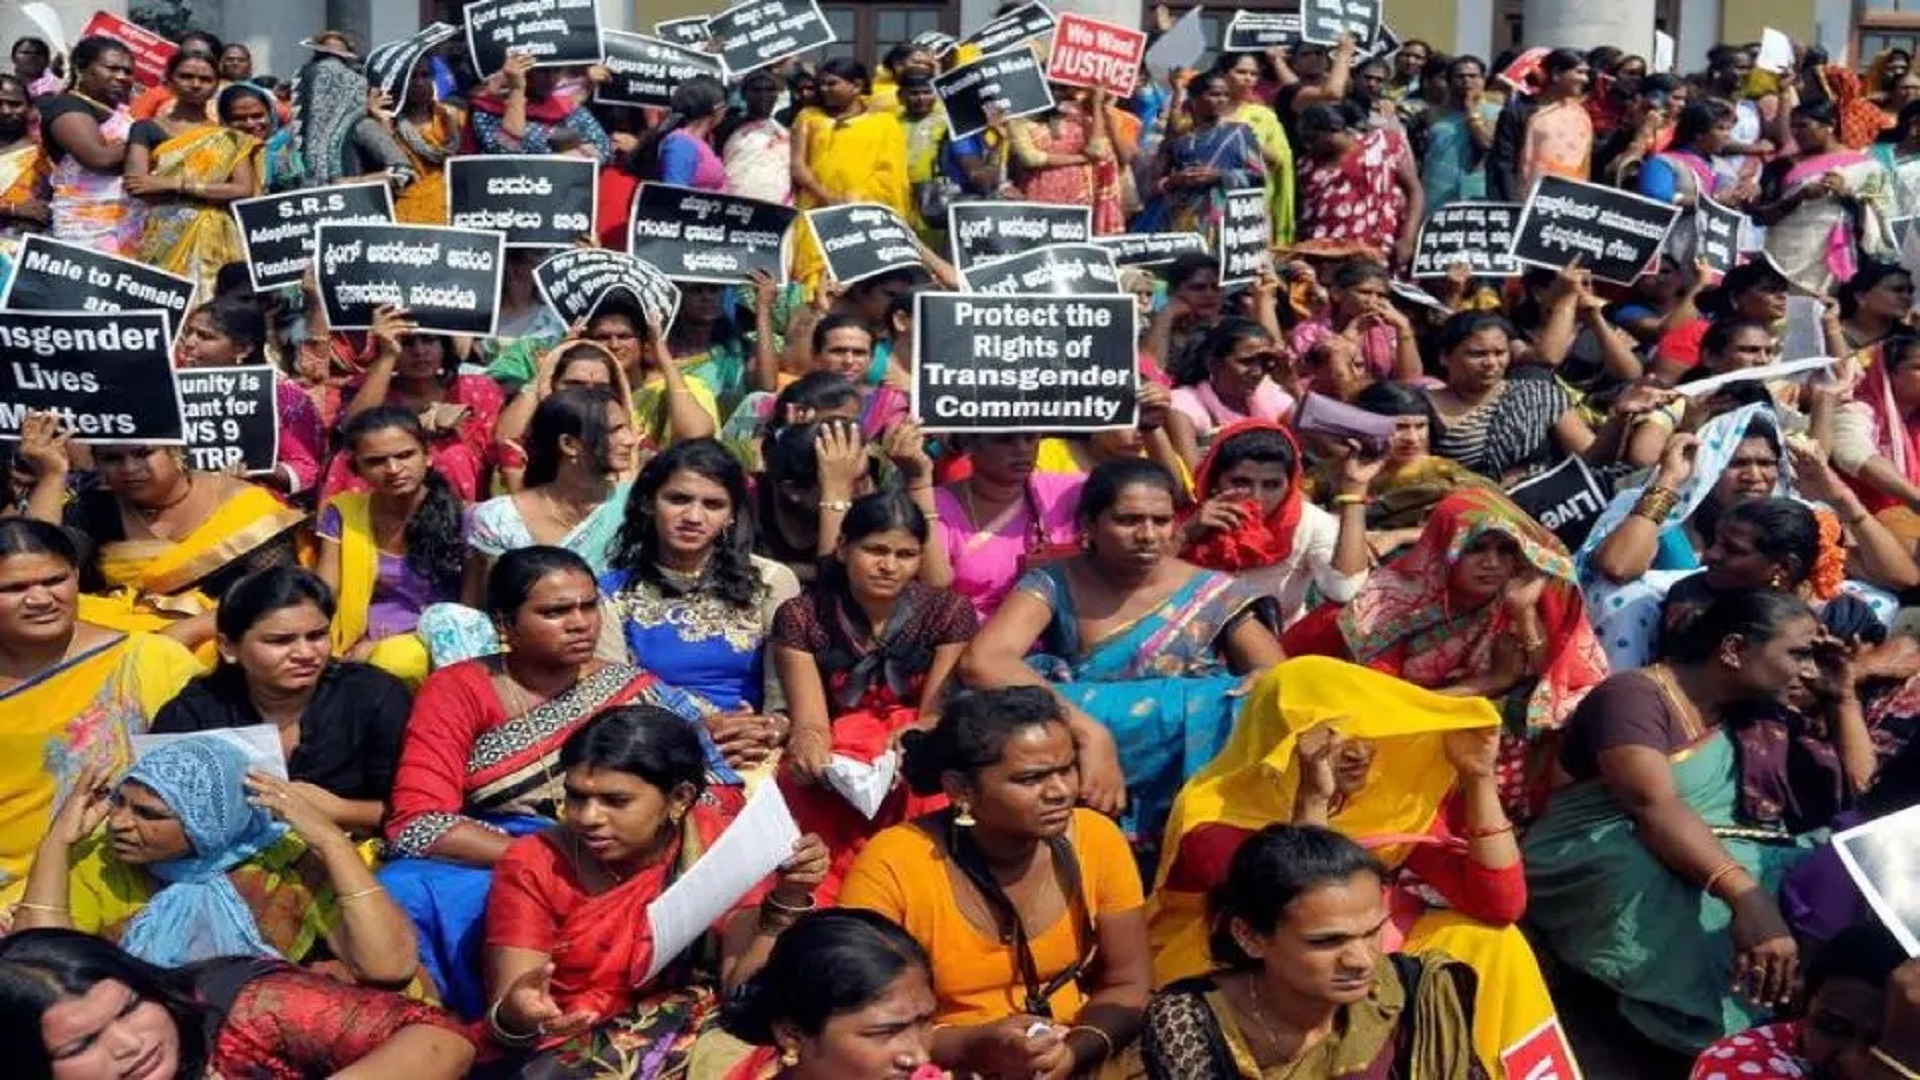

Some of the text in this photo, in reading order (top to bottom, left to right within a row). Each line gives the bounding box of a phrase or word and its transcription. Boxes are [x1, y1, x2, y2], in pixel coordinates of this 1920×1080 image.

[1067, 22, 1094, 45] We
[1098, 30, 1136, 57] Want
[1053, 48, 1133, 87] JUSTICE
[25, 251, 186, 311] Male to Female
[955, 302, 1111, 327] Protect the
[973, 335, 1093, 363] Rights of
[11, 361, 100, 393] Lives
[923, 362, 1130, 391] Transgender
[0, 402, 137, 434] Mtters
[226, 398, 258, 416] for
[935, 394, 1121, 421] Community
[222, 420, 240, 441] 9
[189, 447, 244, 469] TRP
